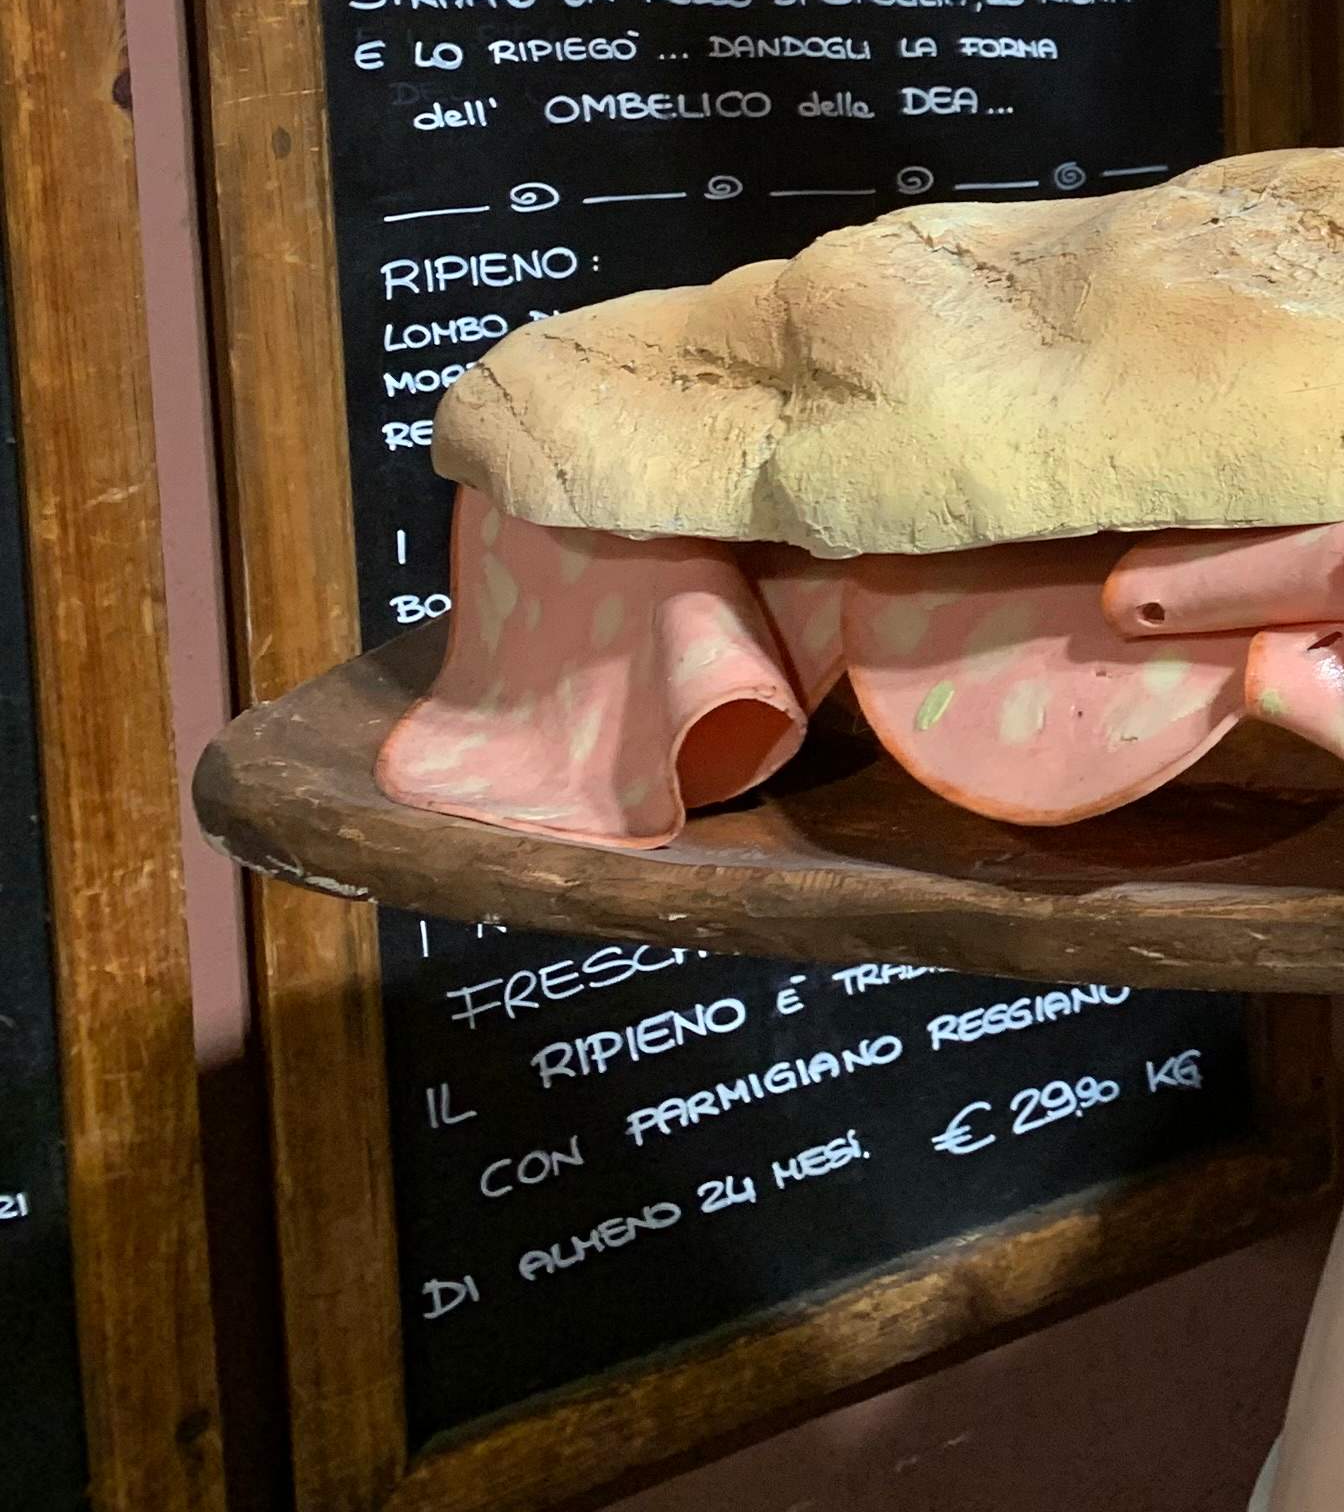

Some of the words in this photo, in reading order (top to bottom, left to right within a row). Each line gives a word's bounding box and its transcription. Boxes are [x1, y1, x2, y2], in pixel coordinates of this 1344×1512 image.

[415, 42, 463, 69] LO
[710, 36, 870, 59] DANDOGLI
[901, 38, 937, 57] LA
[959, 38, 1057, 59] FORMA
[545, 92, 770, 123] OMBELICO
[384, 315, 508, 351] LOMBO
[427, 1083, 477, 1128] IL
[532, 998, 745, 1088] RIPIENO
[481, 1135, 584, 1197] CON
[626, 1027, 902, 1146] PARMIGIANO
[927, 984, 1130, 1050] REGGIANO
[423, 1275, 479, 1319] DI
[519, 1202, 681, 1280] ALMENO
[697, 1176, 756, 1212] 24
[931, 1102, 995, 1154] €
[1146, 1049, 1200, 1092] KG
